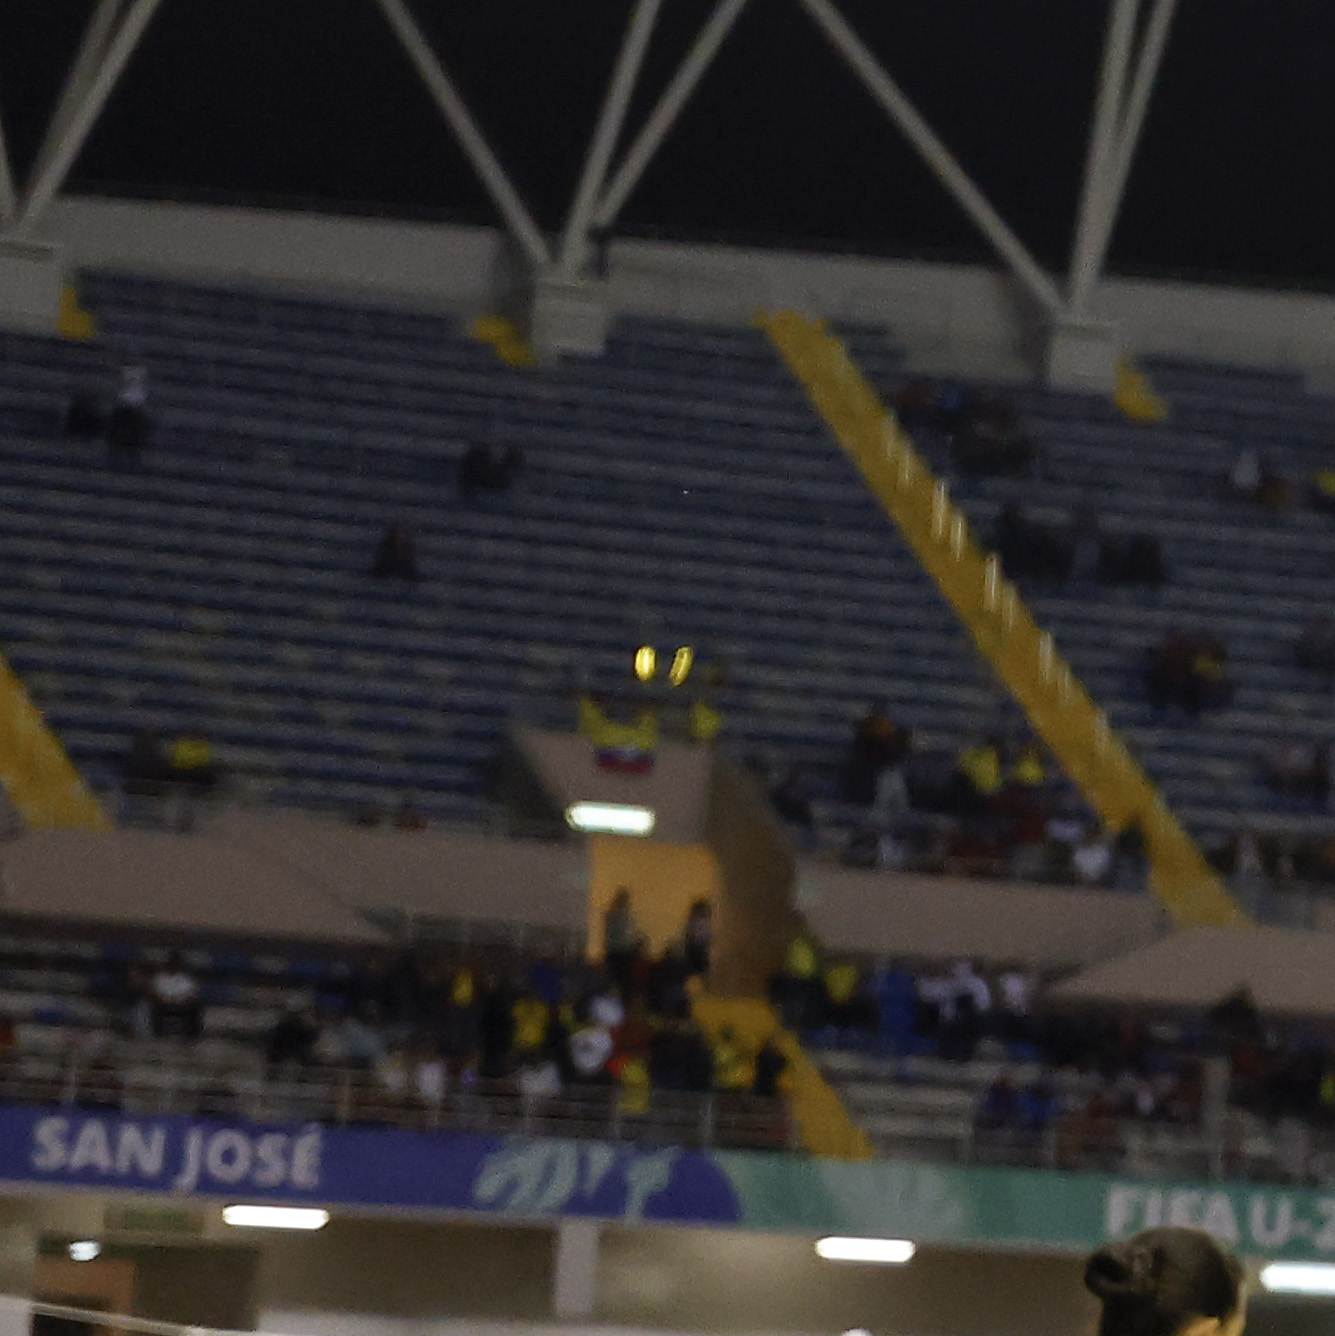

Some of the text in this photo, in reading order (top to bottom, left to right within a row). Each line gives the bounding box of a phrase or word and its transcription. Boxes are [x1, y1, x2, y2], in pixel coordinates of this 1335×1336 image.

[33, 1115, 321, 1190] SAN JOSÉ
[1107, 1183, 1240, 1246] FIFA
